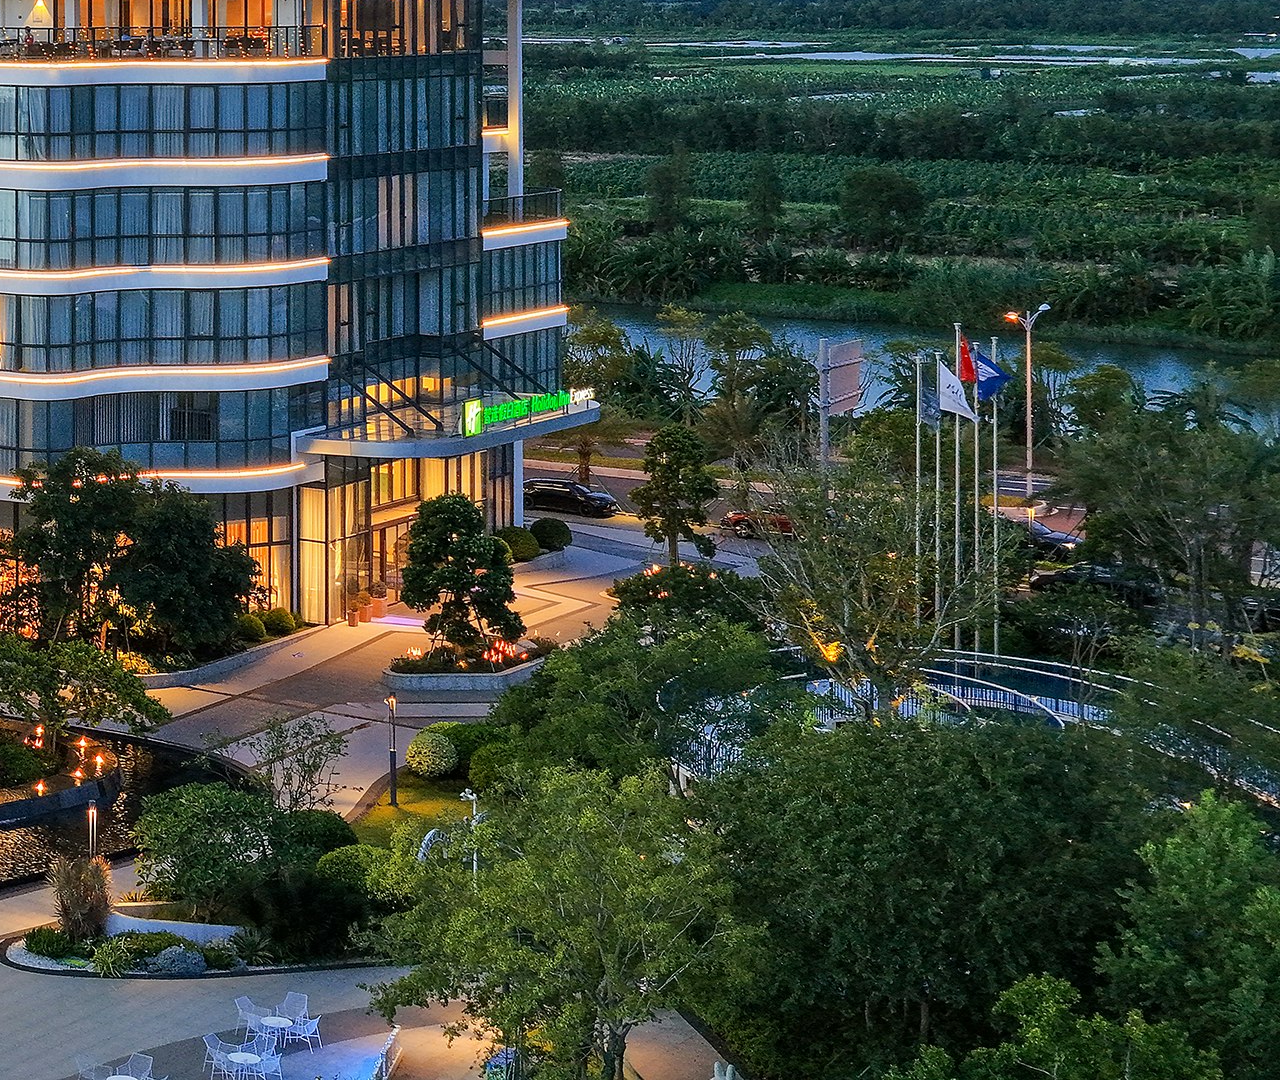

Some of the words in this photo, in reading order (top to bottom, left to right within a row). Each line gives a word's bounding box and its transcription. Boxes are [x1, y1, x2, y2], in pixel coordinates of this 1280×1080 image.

[531, 392, 557, 412] Holiday
[557, 389, 570, 406] Inn
[570, 387, 595, 405] Express
